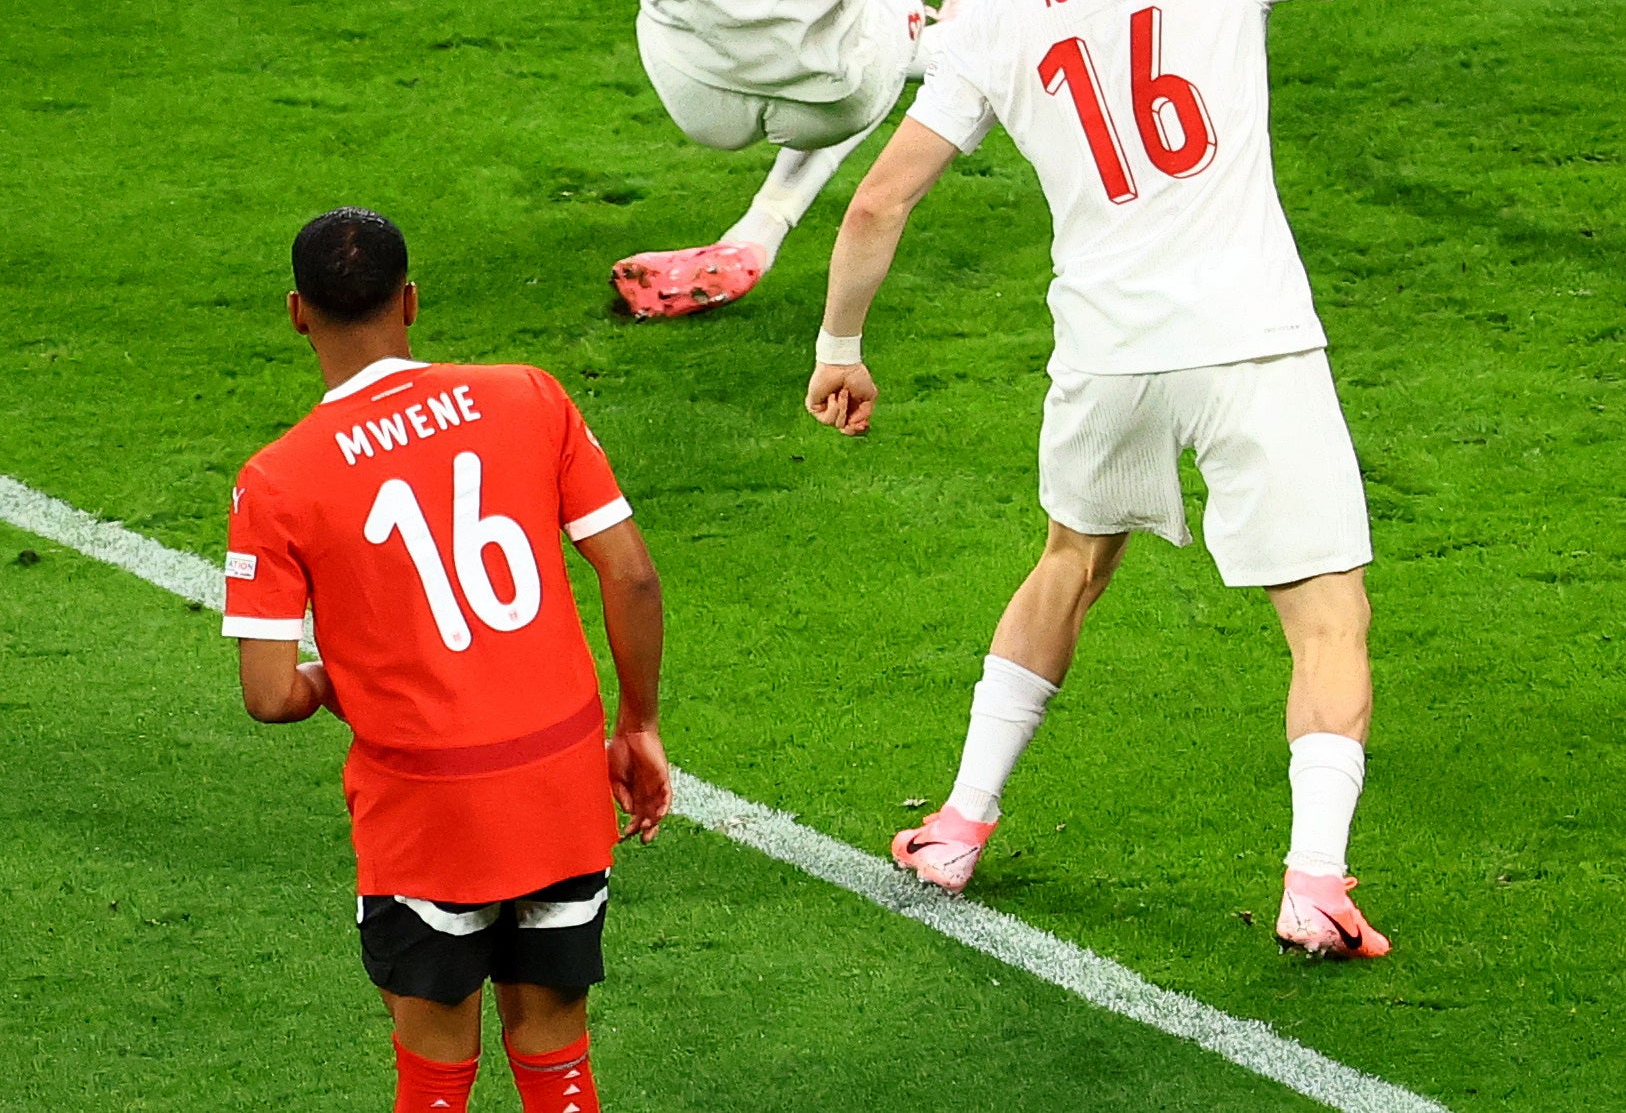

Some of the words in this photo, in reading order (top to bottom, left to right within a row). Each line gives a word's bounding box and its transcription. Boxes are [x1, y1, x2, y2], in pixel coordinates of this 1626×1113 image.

[1037, 6, 1218, 205] 16
[335, 385, 481, 466] MWENE
[363, 451, 541, 652] 16
